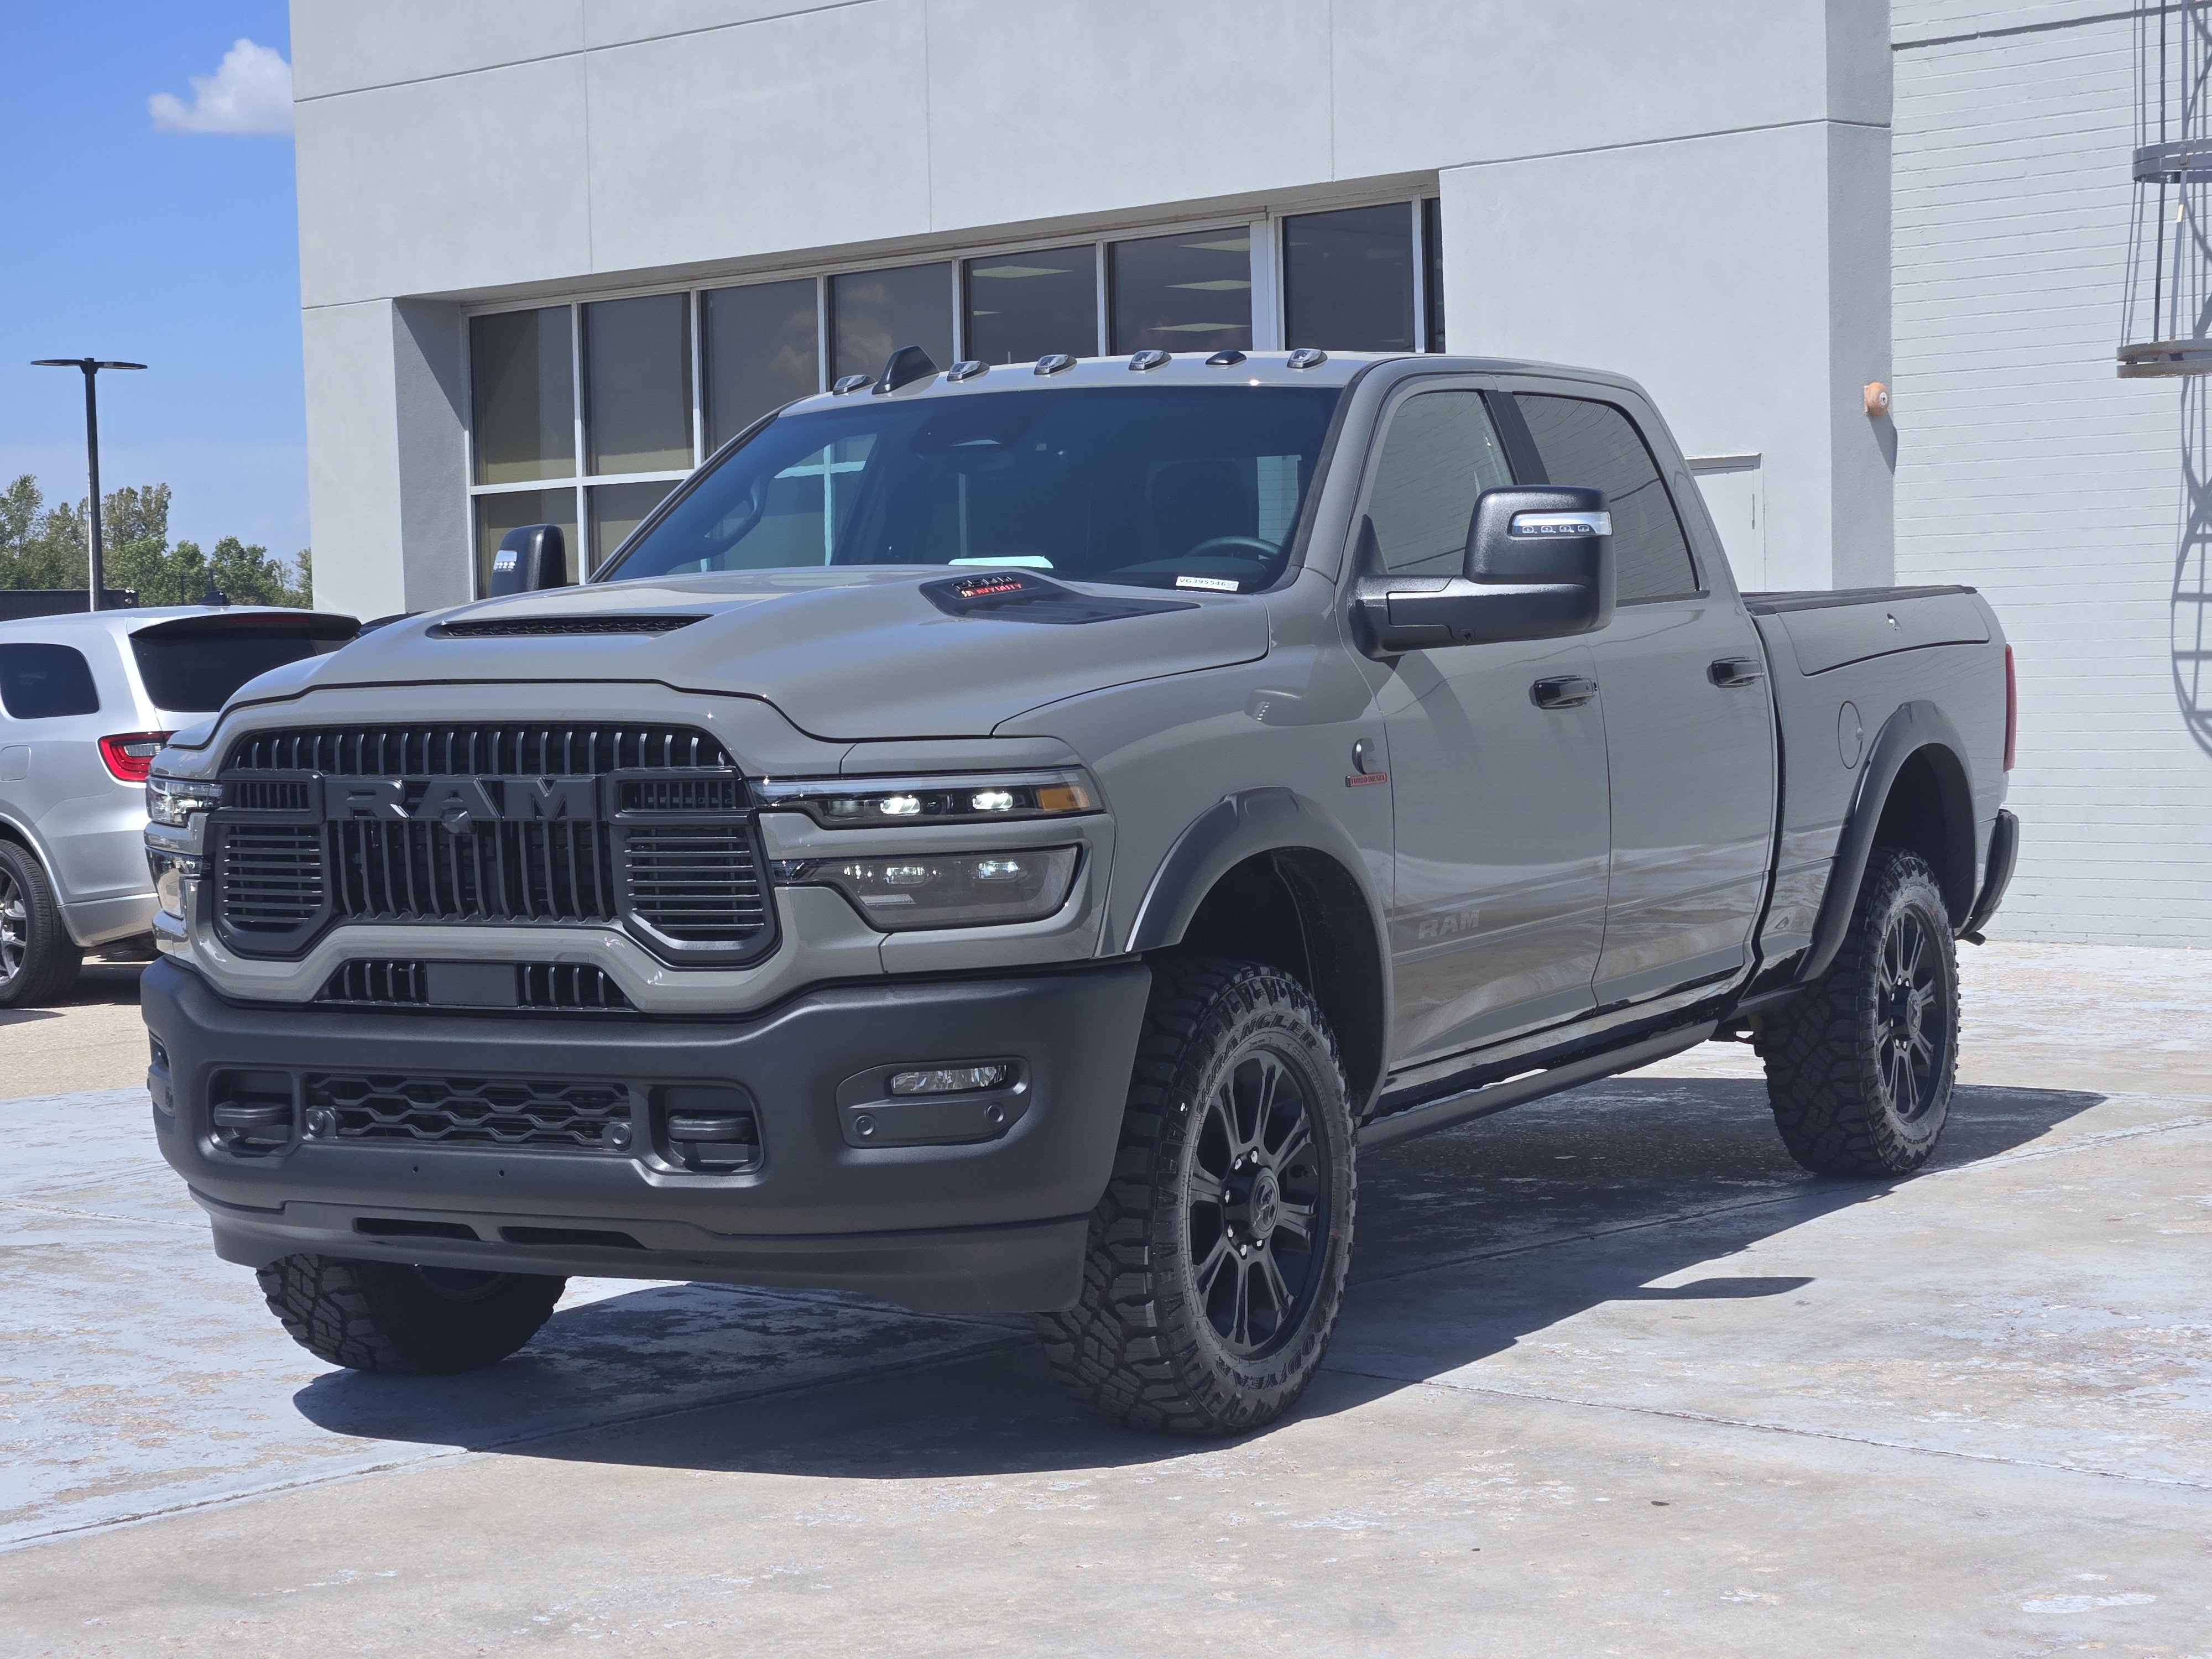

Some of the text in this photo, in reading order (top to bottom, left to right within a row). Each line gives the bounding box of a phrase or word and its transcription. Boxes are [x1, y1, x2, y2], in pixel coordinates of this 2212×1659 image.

[325, 777, 597, 820] RAM
[1418, 909, 1480, 940] RAM
[1215, 1277, 1337, 1390] GOODYEAR
